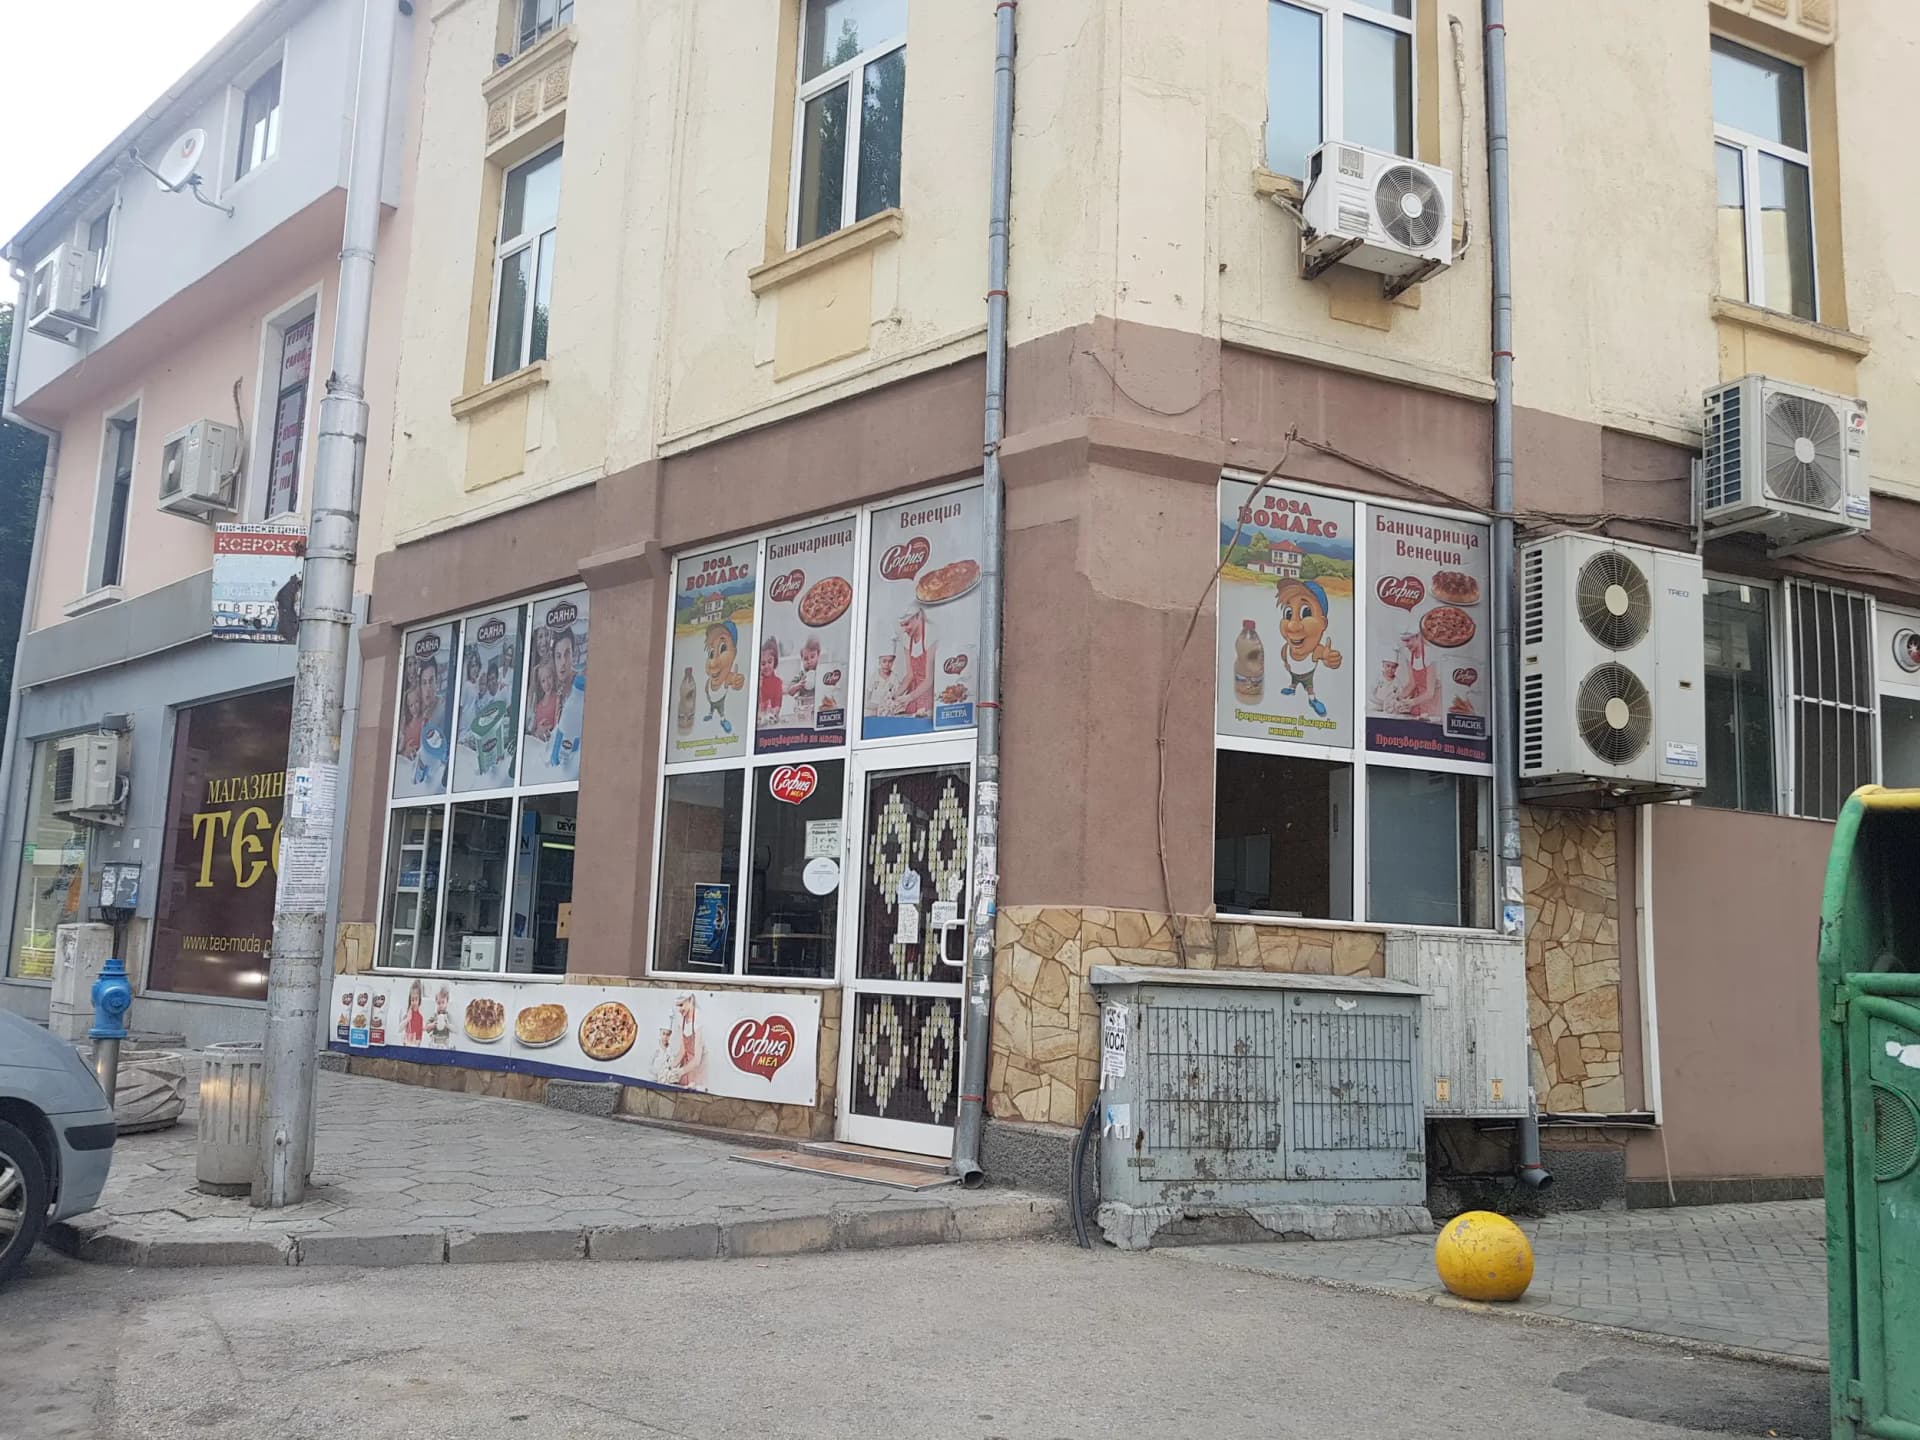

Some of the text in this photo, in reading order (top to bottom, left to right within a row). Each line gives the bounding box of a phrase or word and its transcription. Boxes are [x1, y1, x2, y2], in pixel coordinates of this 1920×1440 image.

[901, 503, 961, 528] Венеция
[1264, 495, 1312, 516] БОЗА
[1237, 506, 1338, 538] БОМАКС
[1376, 515, 1479, 550] Баничарница
[770, 529, 852, 560] Баничарница
[1396, 539, 1461, 566] Венеция
[702, 554, 733, 572] БОЗА
[882, 544, 926, 576] София
[686, 563, 749, 591] БОМАКС
[771, 575, 801, 599] София
[1380, 577, 1420, 603] София
[1450, 719, 1482, 730] КЛАСИК
[759, 733, 808, 749] Производство
[1375, 733, 1442, 751] Производство
[206, 771, 285, 804] МАГАЗИН
[774, 769, 811, 797] София
[731, 1022, 788, 1067] София
[1105, 1032, 1125, 1052] КОСА
[757, 1056, 778, 1067] МЕЛ
